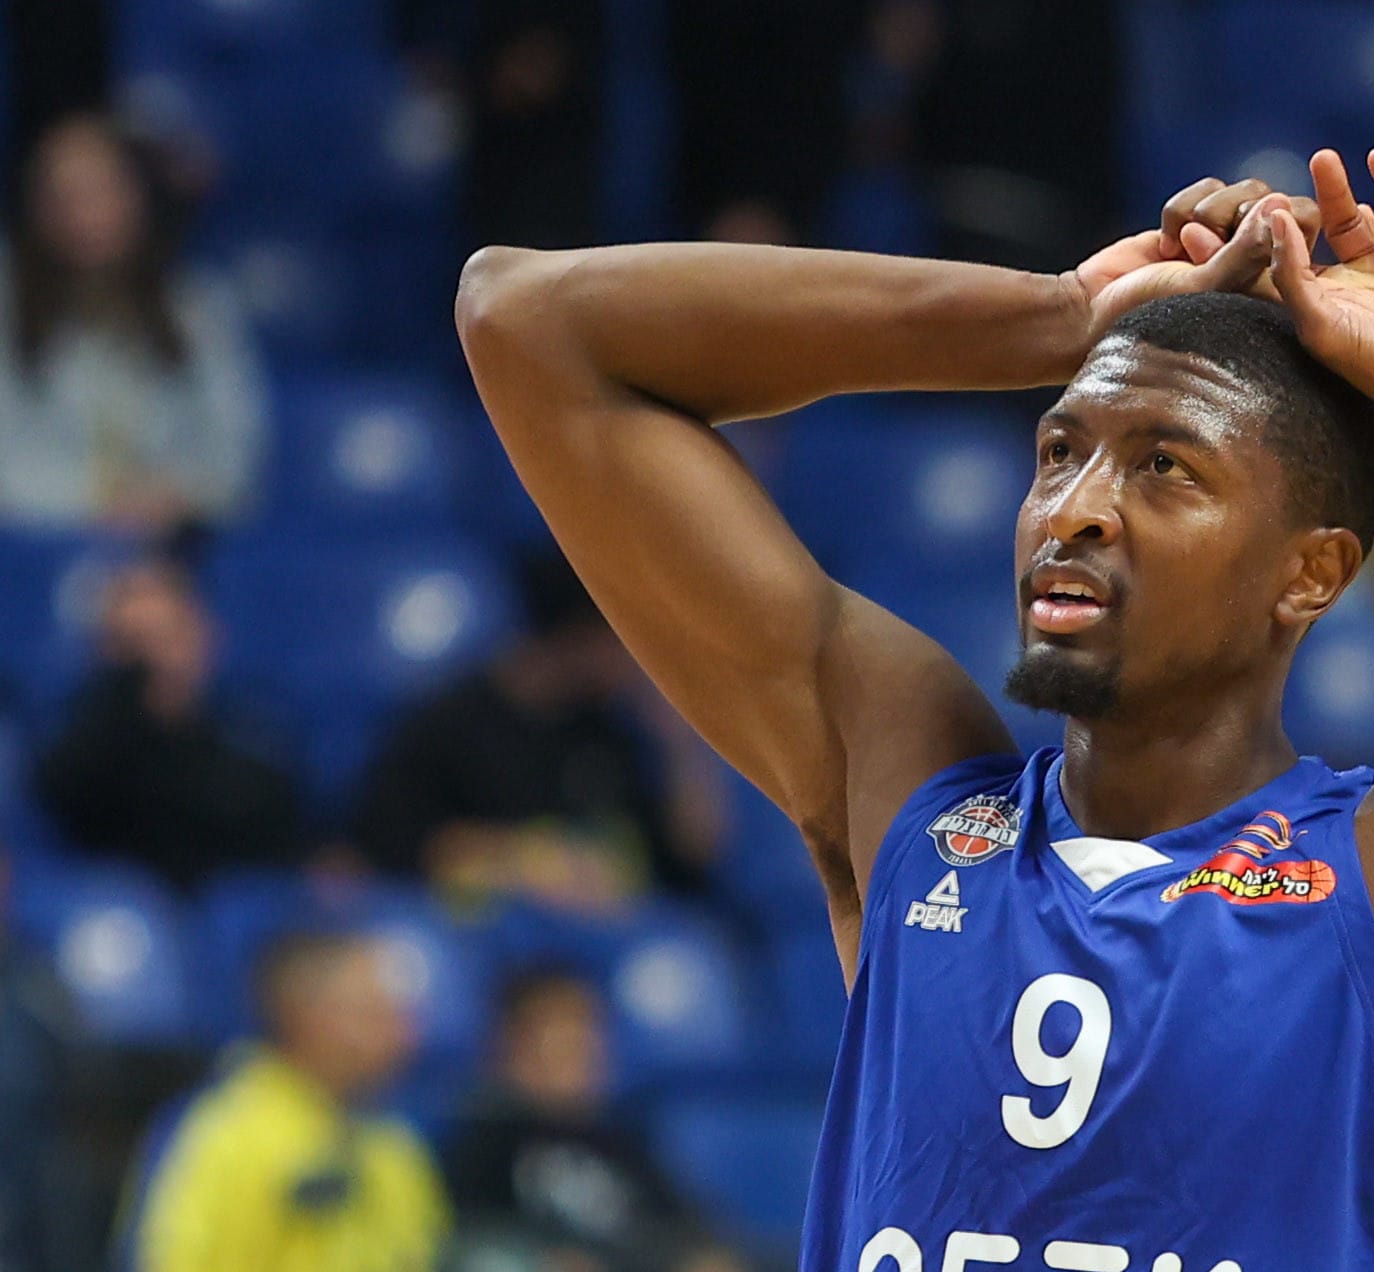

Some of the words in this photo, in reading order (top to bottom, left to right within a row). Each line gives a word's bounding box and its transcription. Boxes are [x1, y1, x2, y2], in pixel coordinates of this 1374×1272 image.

[1282, 875, 1310, 895] סל
[905, 901, 967, 933] PEAK
[1001, 973, 1111, 1149] 9
